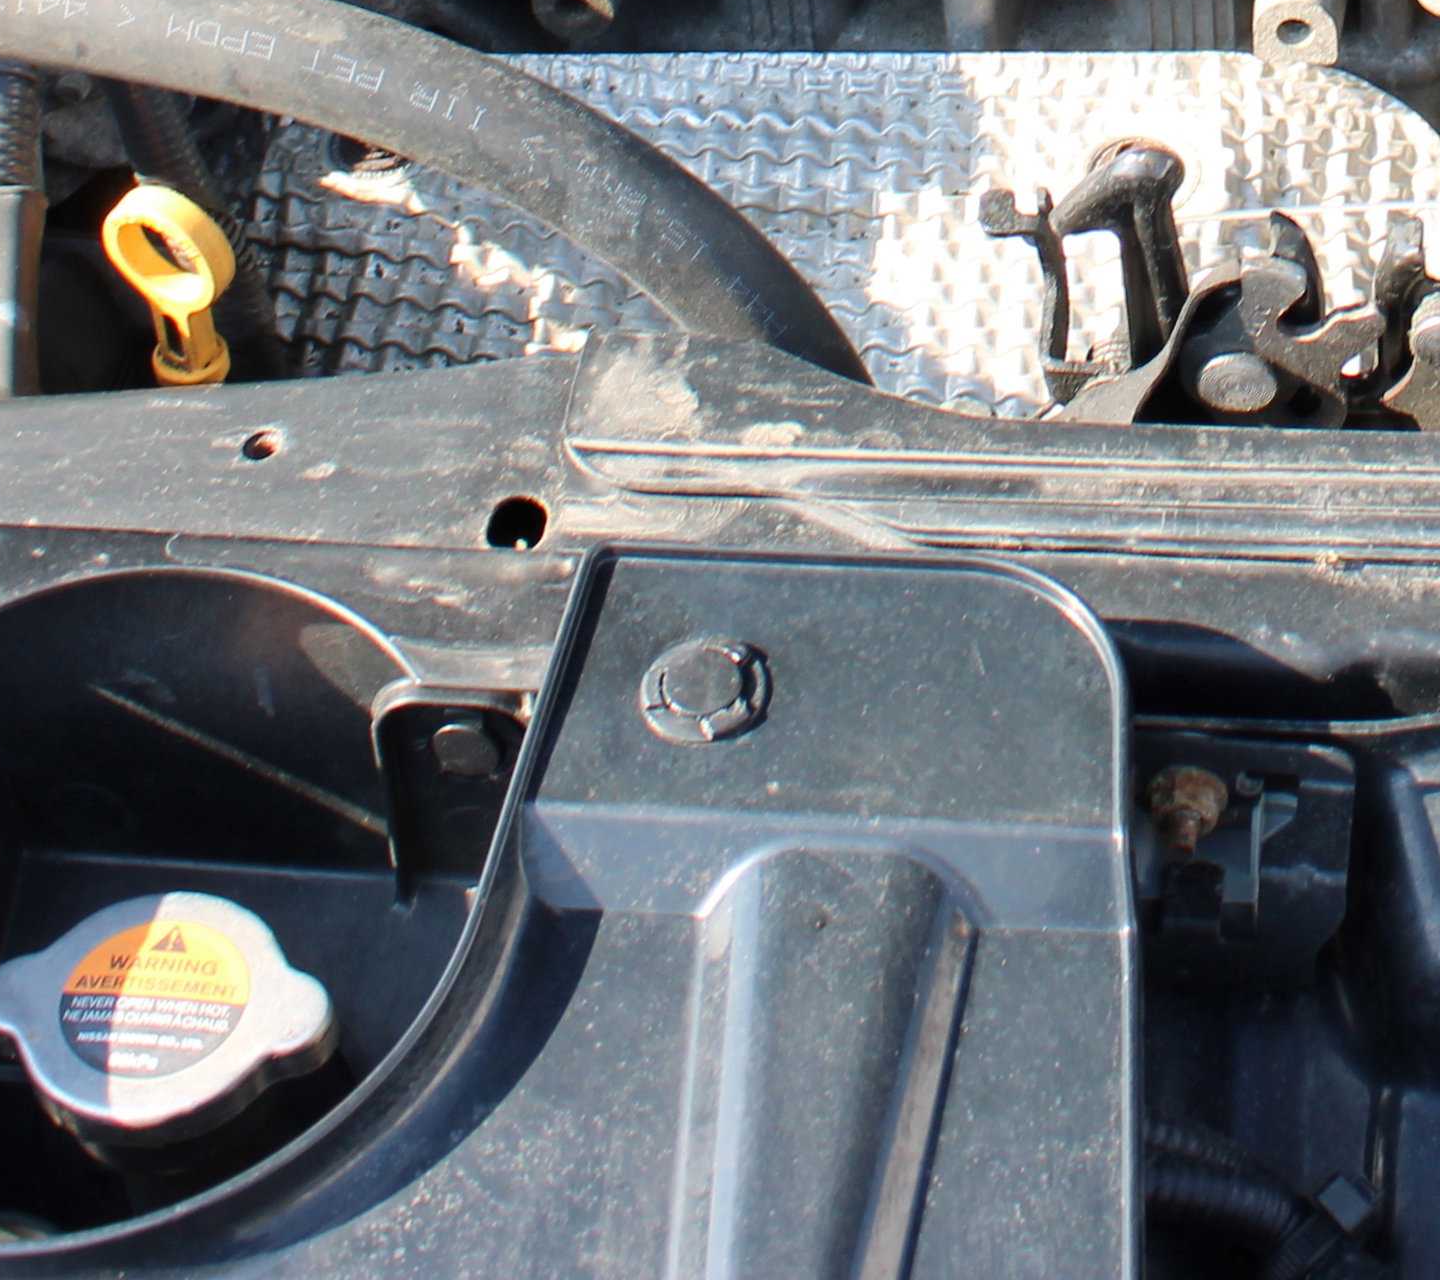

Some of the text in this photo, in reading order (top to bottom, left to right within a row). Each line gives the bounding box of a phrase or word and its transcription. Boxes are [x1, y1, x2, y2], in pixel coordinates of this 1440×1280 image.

[166, 13, 277, 61] EPDM
[300, 48, 385, 95] PET
[109, 954, 219, 975] WARNING
[75, 974, 239, 999] AVERTISSEMENT
[71, 995, 114, 1010] NEVER
[116, 998, 155, 1011] OPEN
[156, 1000, 198, 1014] WHEN
[62, 1009, 81, 1022] NE
[81, 1009, 123, 1024] JAMAIS
[123, 1012, 170, 1027] OUVRIR
[76, 1032, 118, 1042] NISSAN
[118, 1033, 158, 1045] MOTOR
